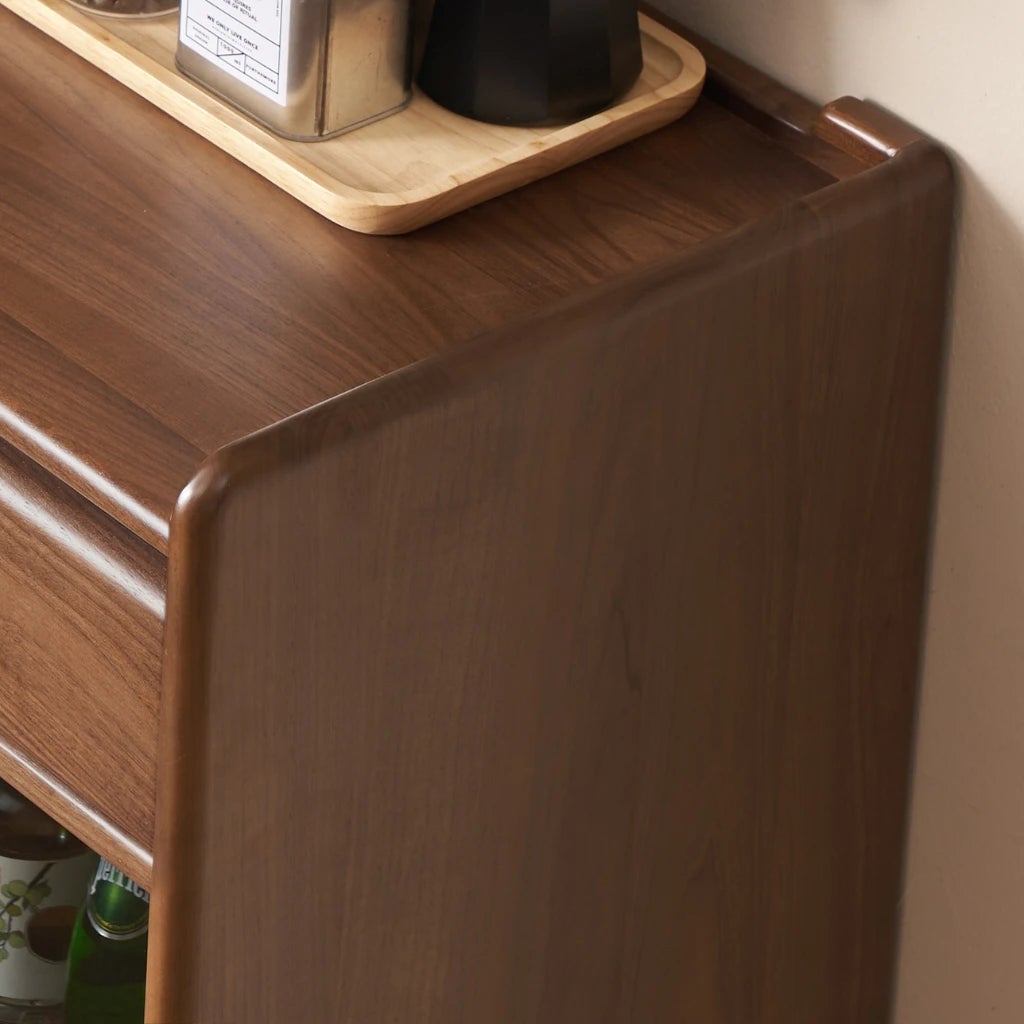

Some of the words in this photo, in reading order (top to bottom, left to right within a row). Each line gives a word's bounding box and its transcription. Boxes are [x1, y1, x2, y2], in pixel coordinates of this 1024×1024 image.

[240, 7, 257, 21] RITUAL
[216, 20, 230, 32] ONLY
[231, 29, 242, 40] LIVE
[243, 37, 258, 50] ONCE
